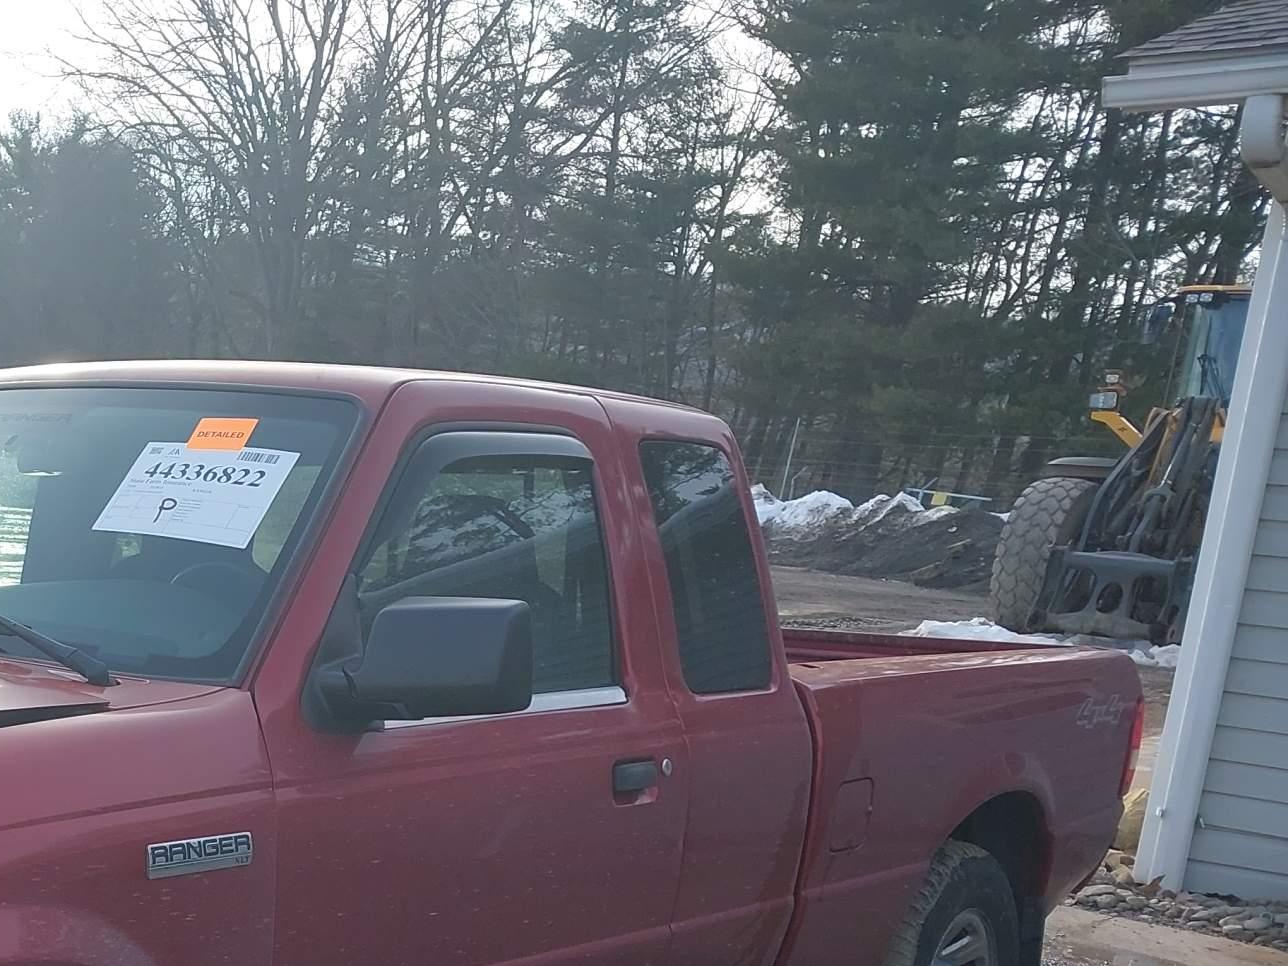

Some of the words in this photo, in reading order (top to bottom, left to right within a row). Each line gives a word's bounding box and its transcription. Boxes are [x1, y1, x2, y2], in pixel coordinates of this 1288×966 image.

[196, 430, 245, 439] DETAILED
[144, 461, 266, 488] 44336822
[150, 834, 251, 865] RANGER
